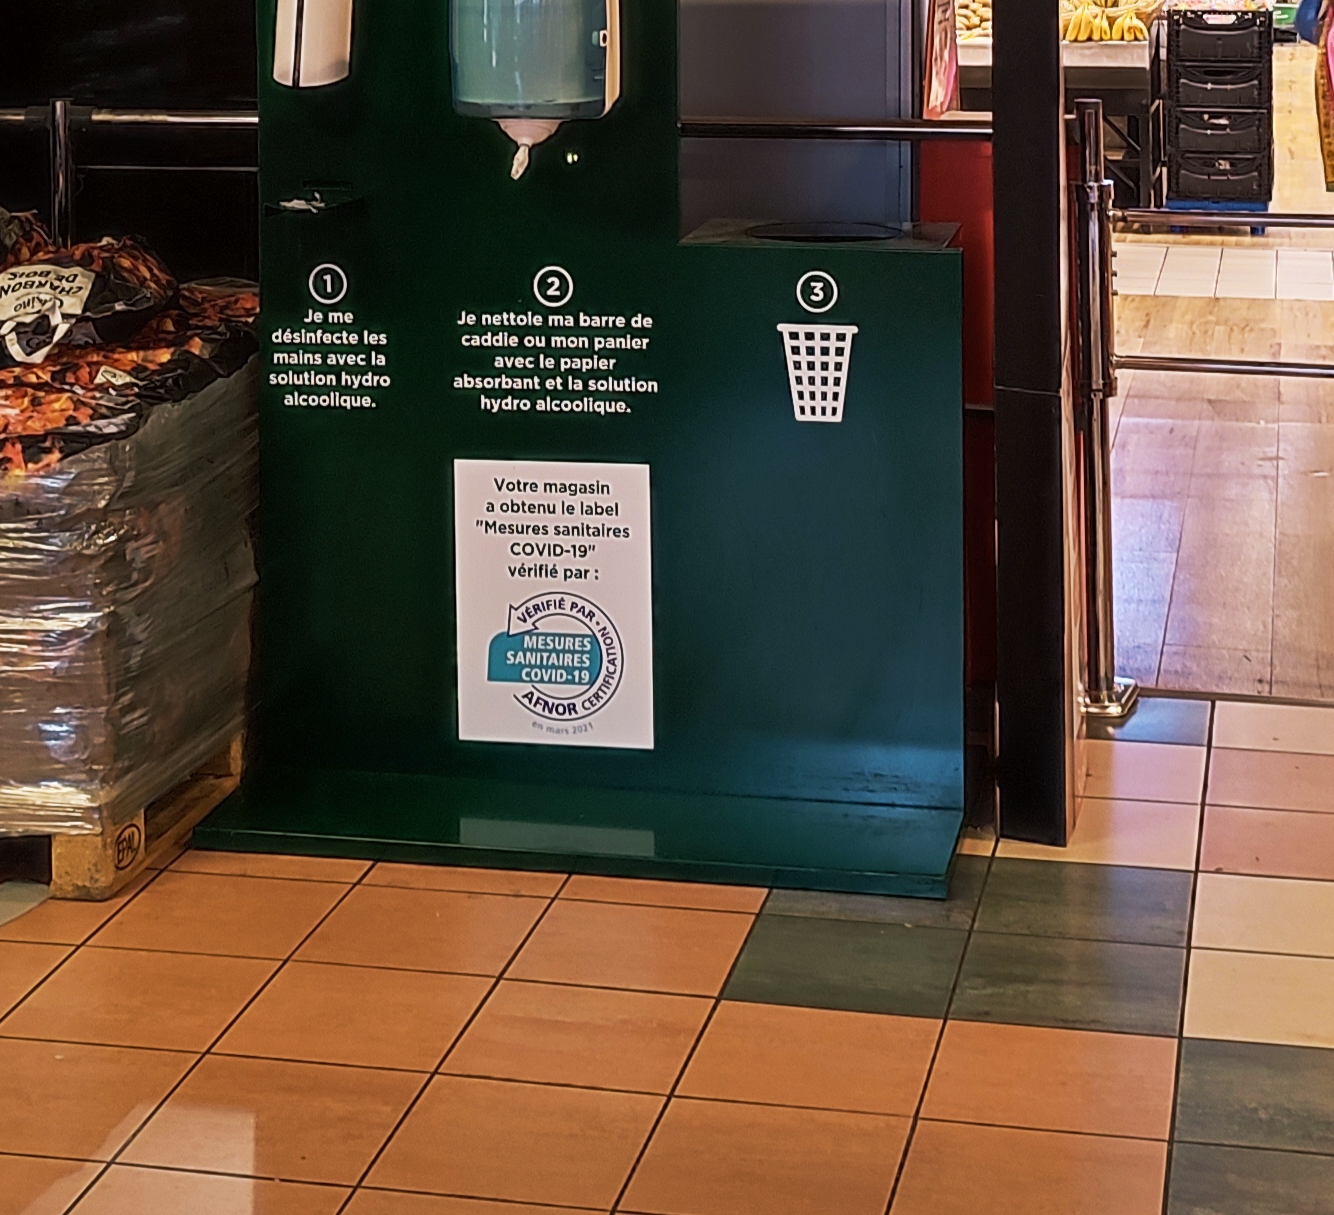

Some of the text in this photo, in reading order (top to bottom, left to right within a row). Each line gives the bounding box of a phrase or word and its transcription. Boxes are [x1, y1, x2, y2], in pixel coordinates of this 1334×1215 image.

[303, 308, 354, 323] Je me
[457, 310, 653, 328] Je nettoie ma barre de
[271, 328, 388, 345] désinfecte les
[461, 331, 649, 351] caddie ou mon panier
[273, 350, 386, 366] mains avec la
[494, 353, 616, 372] avec le papier
[269, 370, 391, 389] solution hydro
[453, 373, 658, 393] absorbant et la solution
[284, 391, 377, 410] alcoolique.
[480, 394, 631, 416] hydro alcoolique.
[494, 477, 610, 496] Votre magasin
[486, 499, 619, 517] a obtenu le label
[475, 519, 630, 538] "Mesures sanitaires
[510, 542, 596, 559] COVID-19"
[508, 562, 590, 581] vérifié par
[517, 596, 596, 624] VÉRIFIÉ PAR
[523, 635, 592, 651] MESURES
[506, 651, 591, 667] SANITAIRES
[521, 626, 618, 716] AFNOR CERTIFICATION
[521, 668, 590, 684] COVID-19
